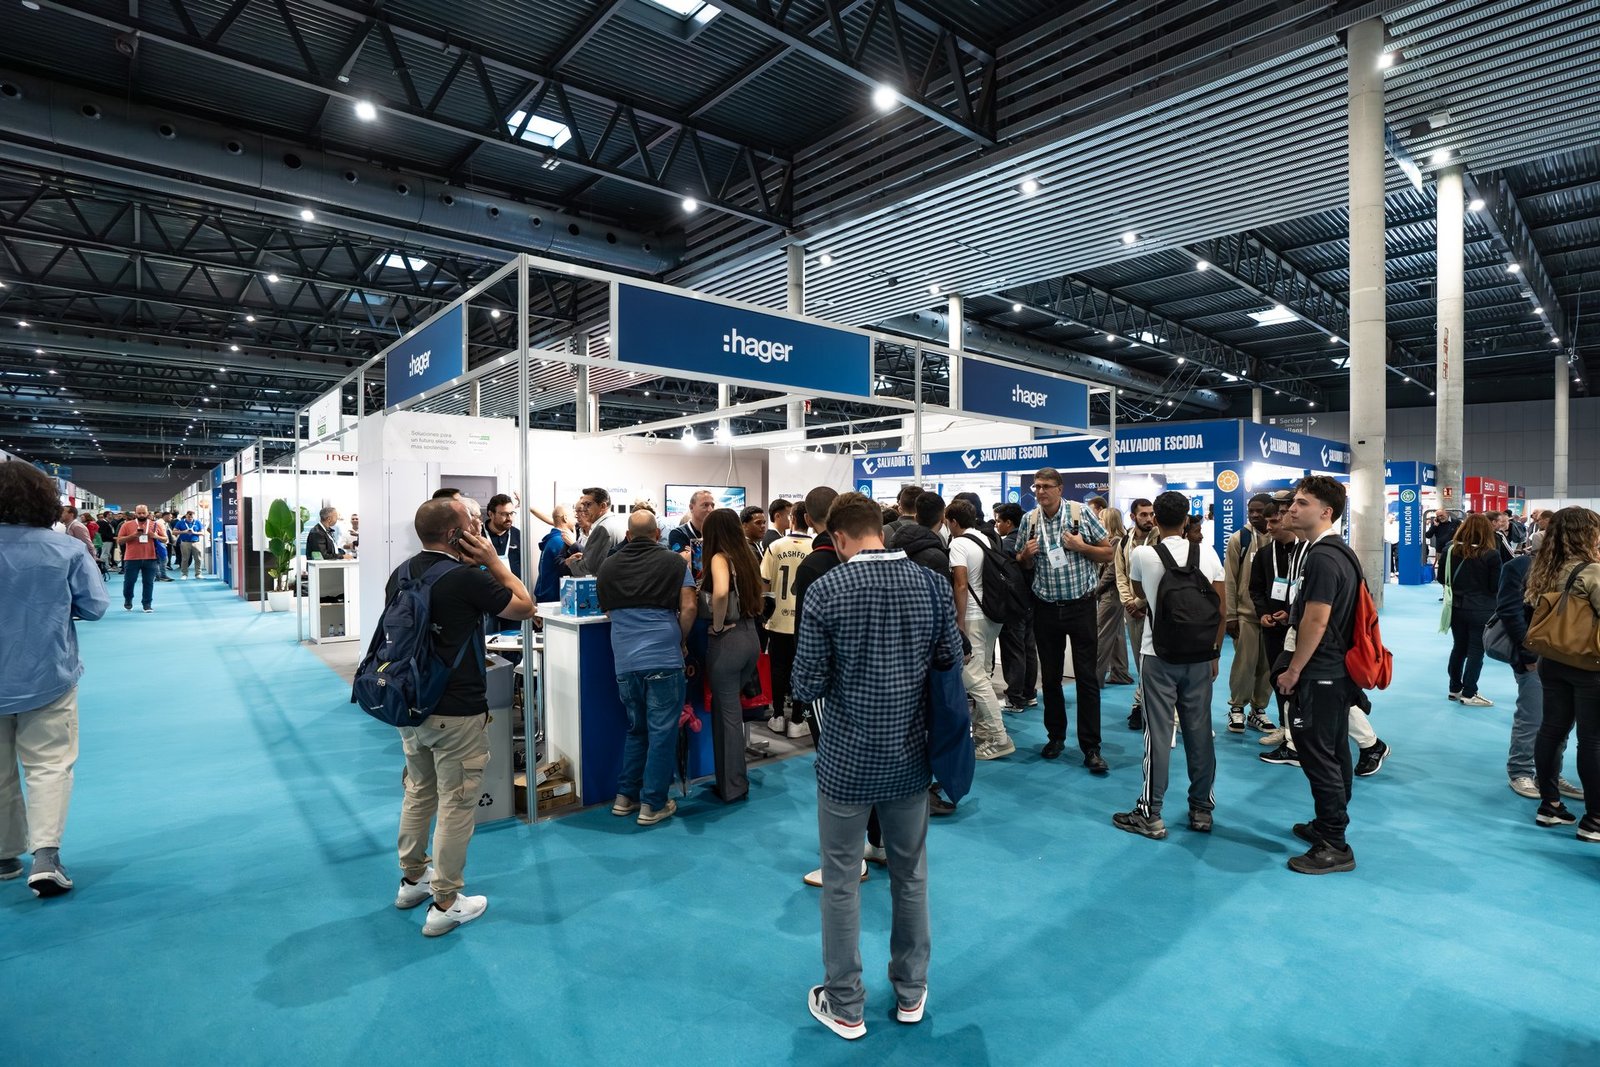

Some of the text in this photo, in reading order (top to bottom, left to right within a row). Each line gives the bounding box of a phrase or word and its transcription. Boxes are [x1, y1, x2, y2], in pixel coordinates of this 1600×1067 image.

[1114, 438, 1161, 454] SALVADOR
[1164, 434, 1204, 451] ESCODA
[877, 456, 906, 468] SALVADOR
[907, 454, 931, 467] ESDA
[980, 447, 1017, 462] SALVADOR
[1018, 445, 1049, 460] ESCODA
